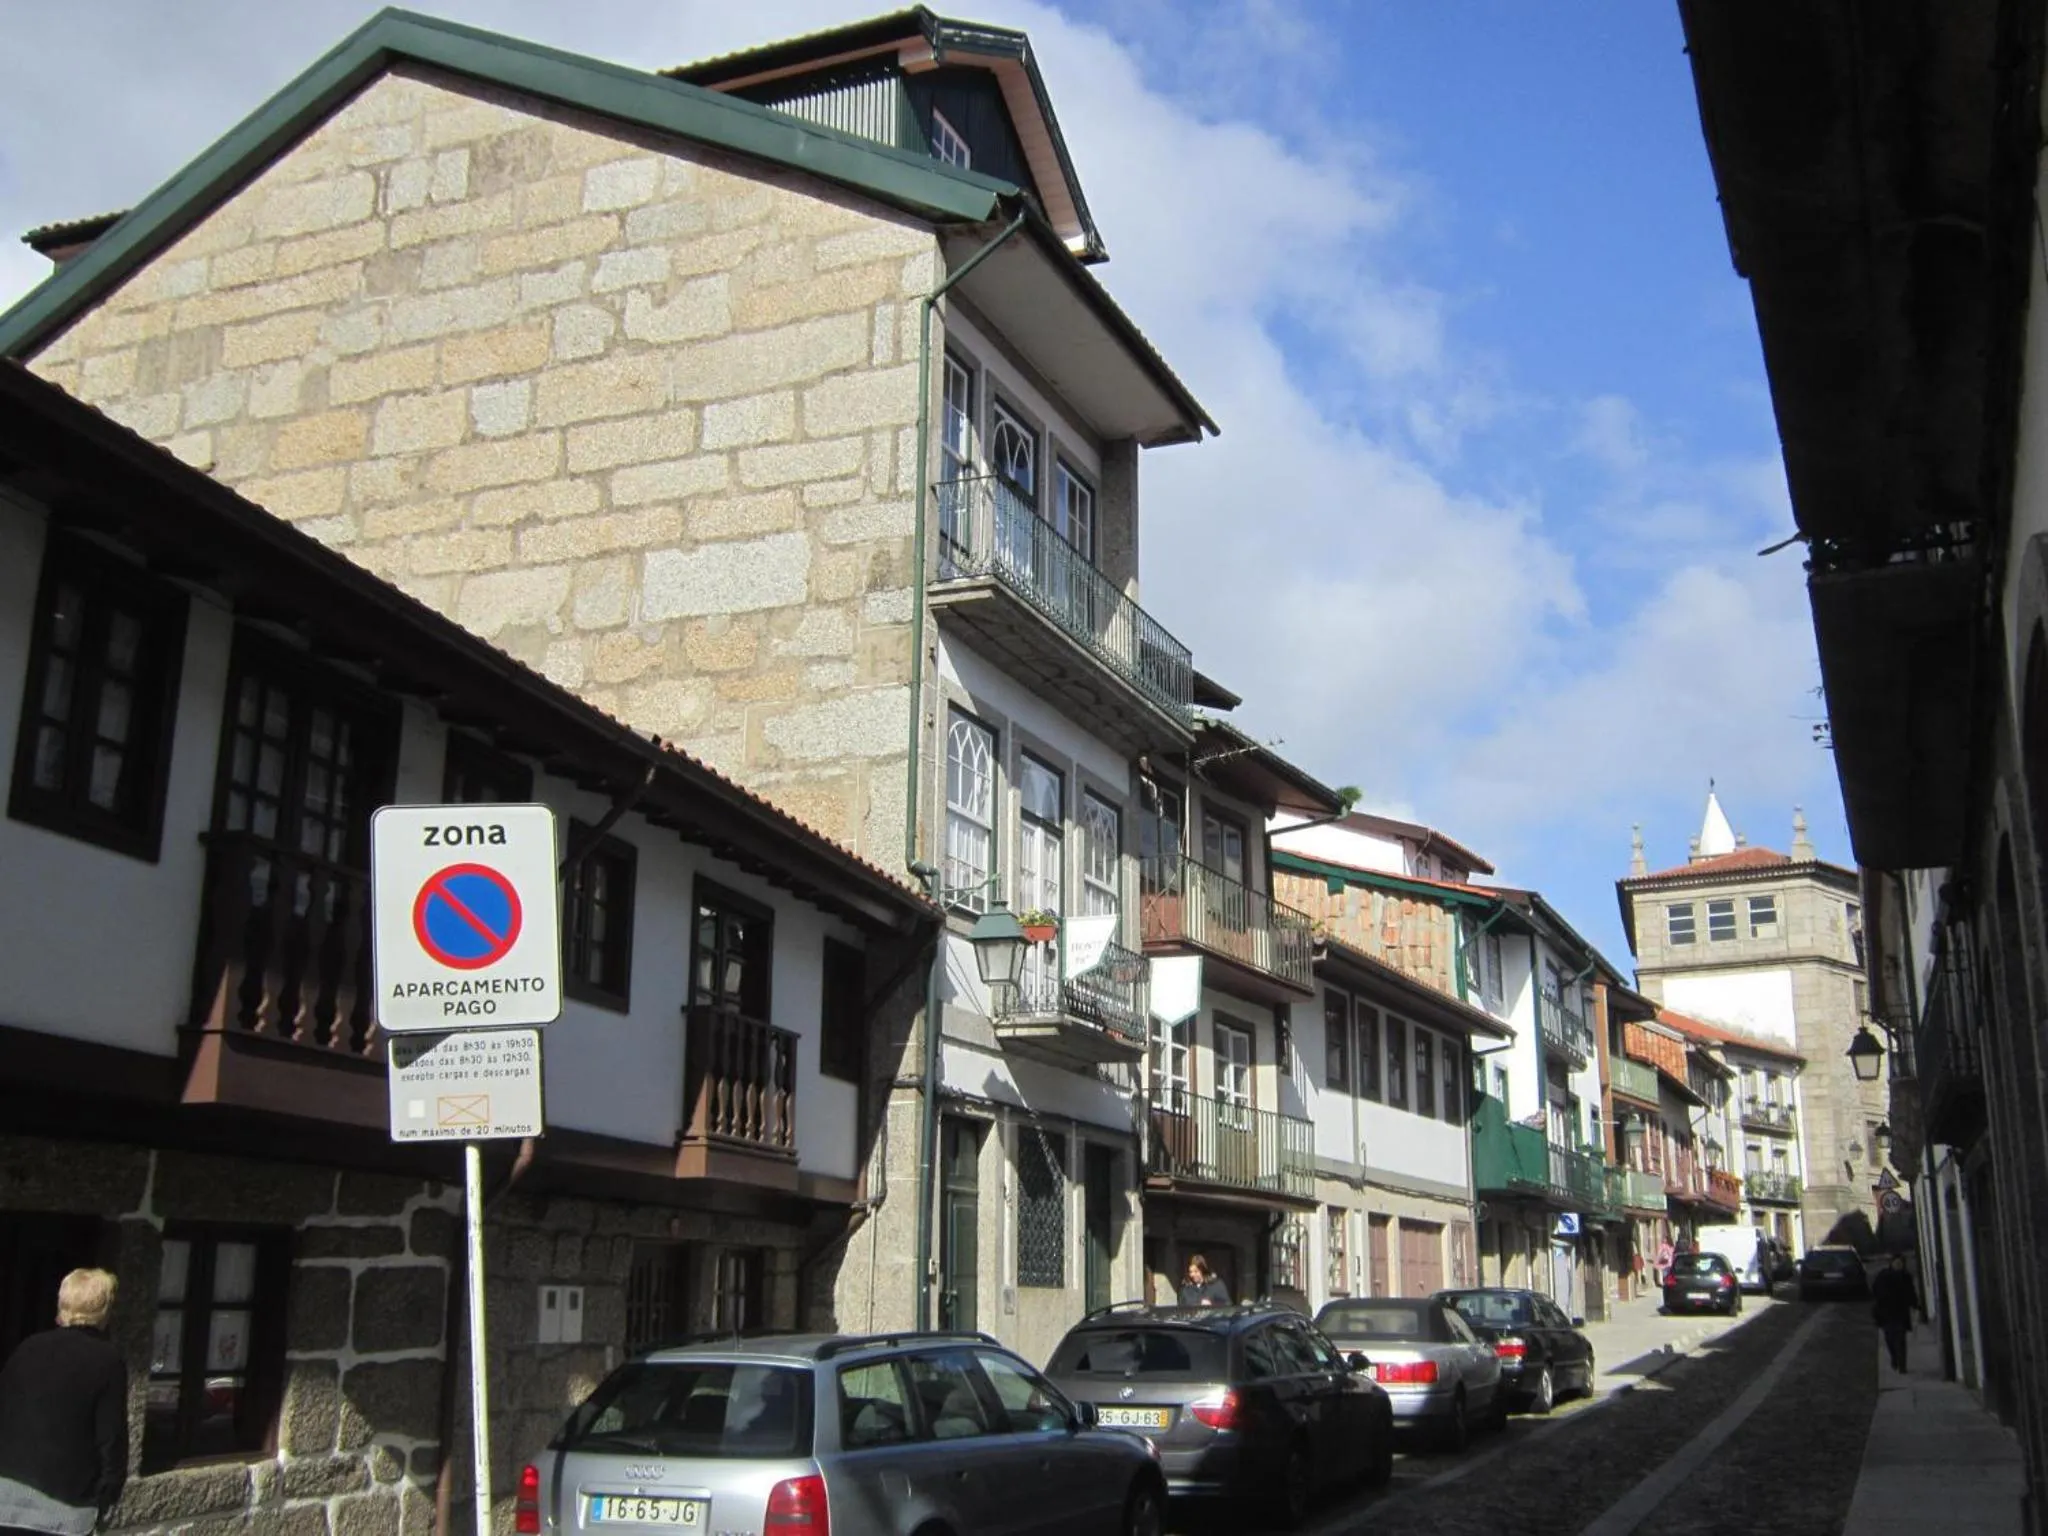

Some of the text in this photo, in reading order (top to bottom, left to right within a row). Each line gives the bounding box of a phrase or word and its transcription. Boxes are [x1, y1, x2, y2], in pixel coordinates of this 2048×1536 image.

[423, 824, 507, 846] zona
[393, 977, 545, 998] APARCAMENTO
[444, 1000, 496, 1016] PAGO
[443, 1043, 458, 1052] das
[463, 1040, 486, 1051] 8h30
[439, 1056, 455, 1066] das
[459, 1053, 481, 1065] 8h30
[440, 1069, 468, 1080] cargas
[483, 1067, 530, 1079] descargas
[399, 1123, 532, 1137] num máximo de 20 minutos
